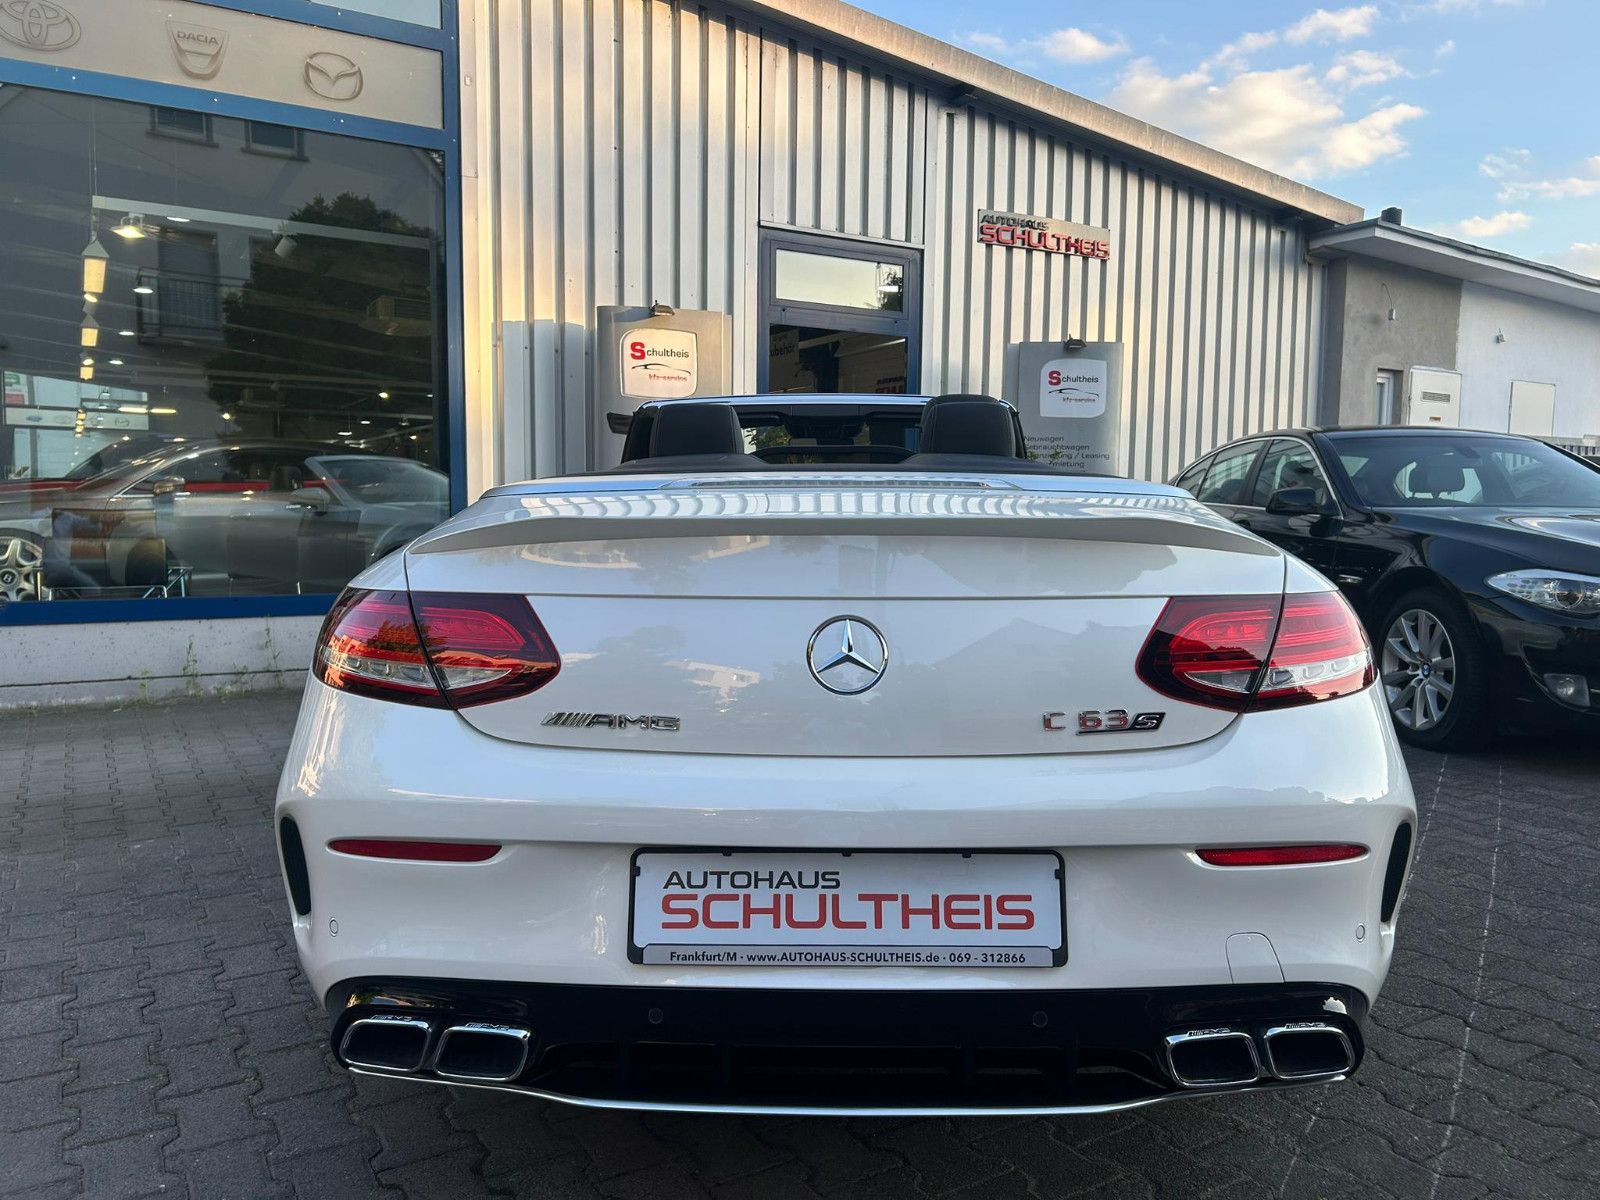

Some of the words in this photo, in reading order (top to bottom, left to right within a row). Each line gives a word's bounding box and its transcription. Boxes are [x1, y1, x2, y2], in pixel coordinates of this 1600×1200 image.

[177, 31, 219, 45] DACIA
[981, 214, 1048, 231] AUTOHAUS
[980, 224, 1109, 258] SCHULTHEIS
[630, 341, 690, 360] Schultheis
[1048, 370, 1099, 386] Schultheis
[586, 713, 681, 731] AMG
[1043, 711, 1066, 731] C
[1078, 705, 1129, 730] 63
[663, 871, 841, 889] AUTOHAUS
[661, 893, 1035, 930] SCHULTHEIS
[670, 951, 737, 963] Frankfurt/M
[747, 952, 940, 964] www.AUTOHAUS-SCHULTHEIS.de
[949, 953, 971, 963] 069
[982, 953, 1026, 964] 312866
